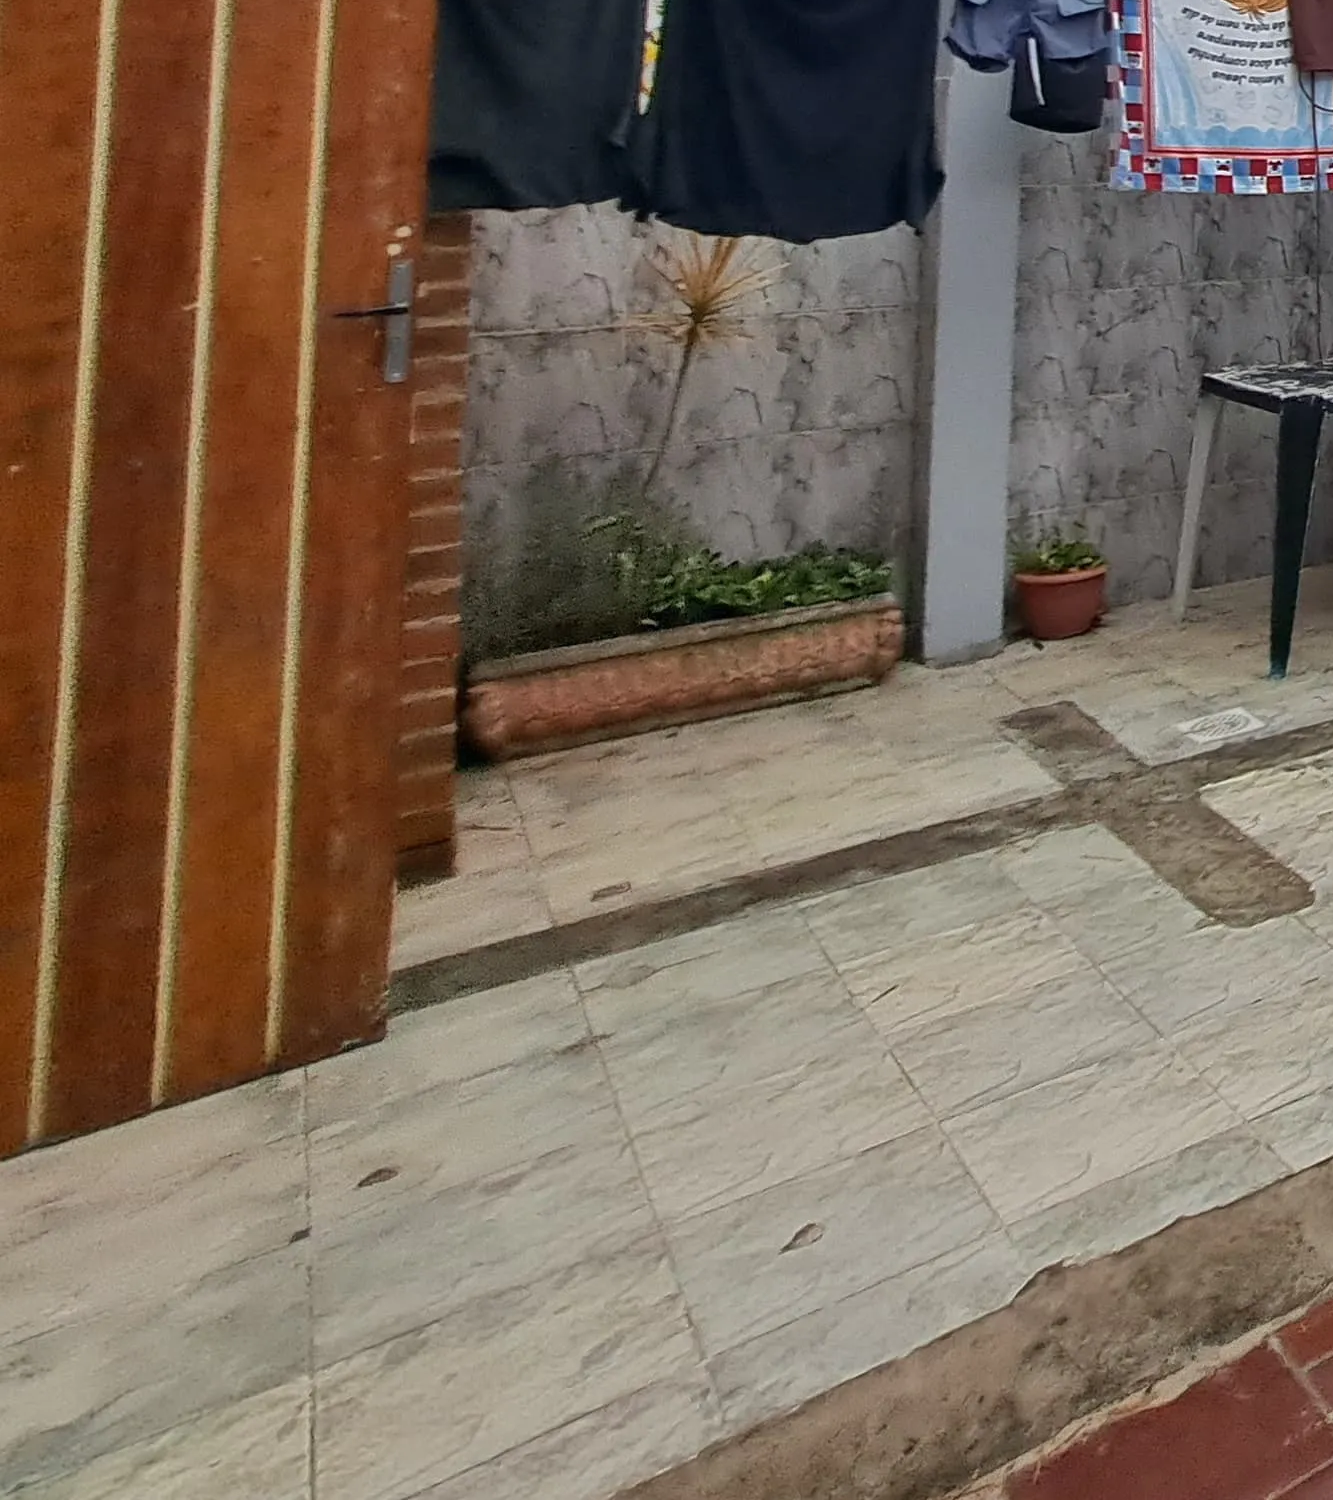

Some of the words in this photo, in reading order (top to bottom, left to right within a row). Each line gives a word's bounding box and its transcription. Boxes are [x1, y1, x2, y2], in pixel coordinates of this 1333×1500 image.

[1181, 7, 1200, 20] dia
[1200, 14, 1215, 25] de
[1272, 21, 1285, 32] de
[1212, 71, 1247, 84] Jesus
